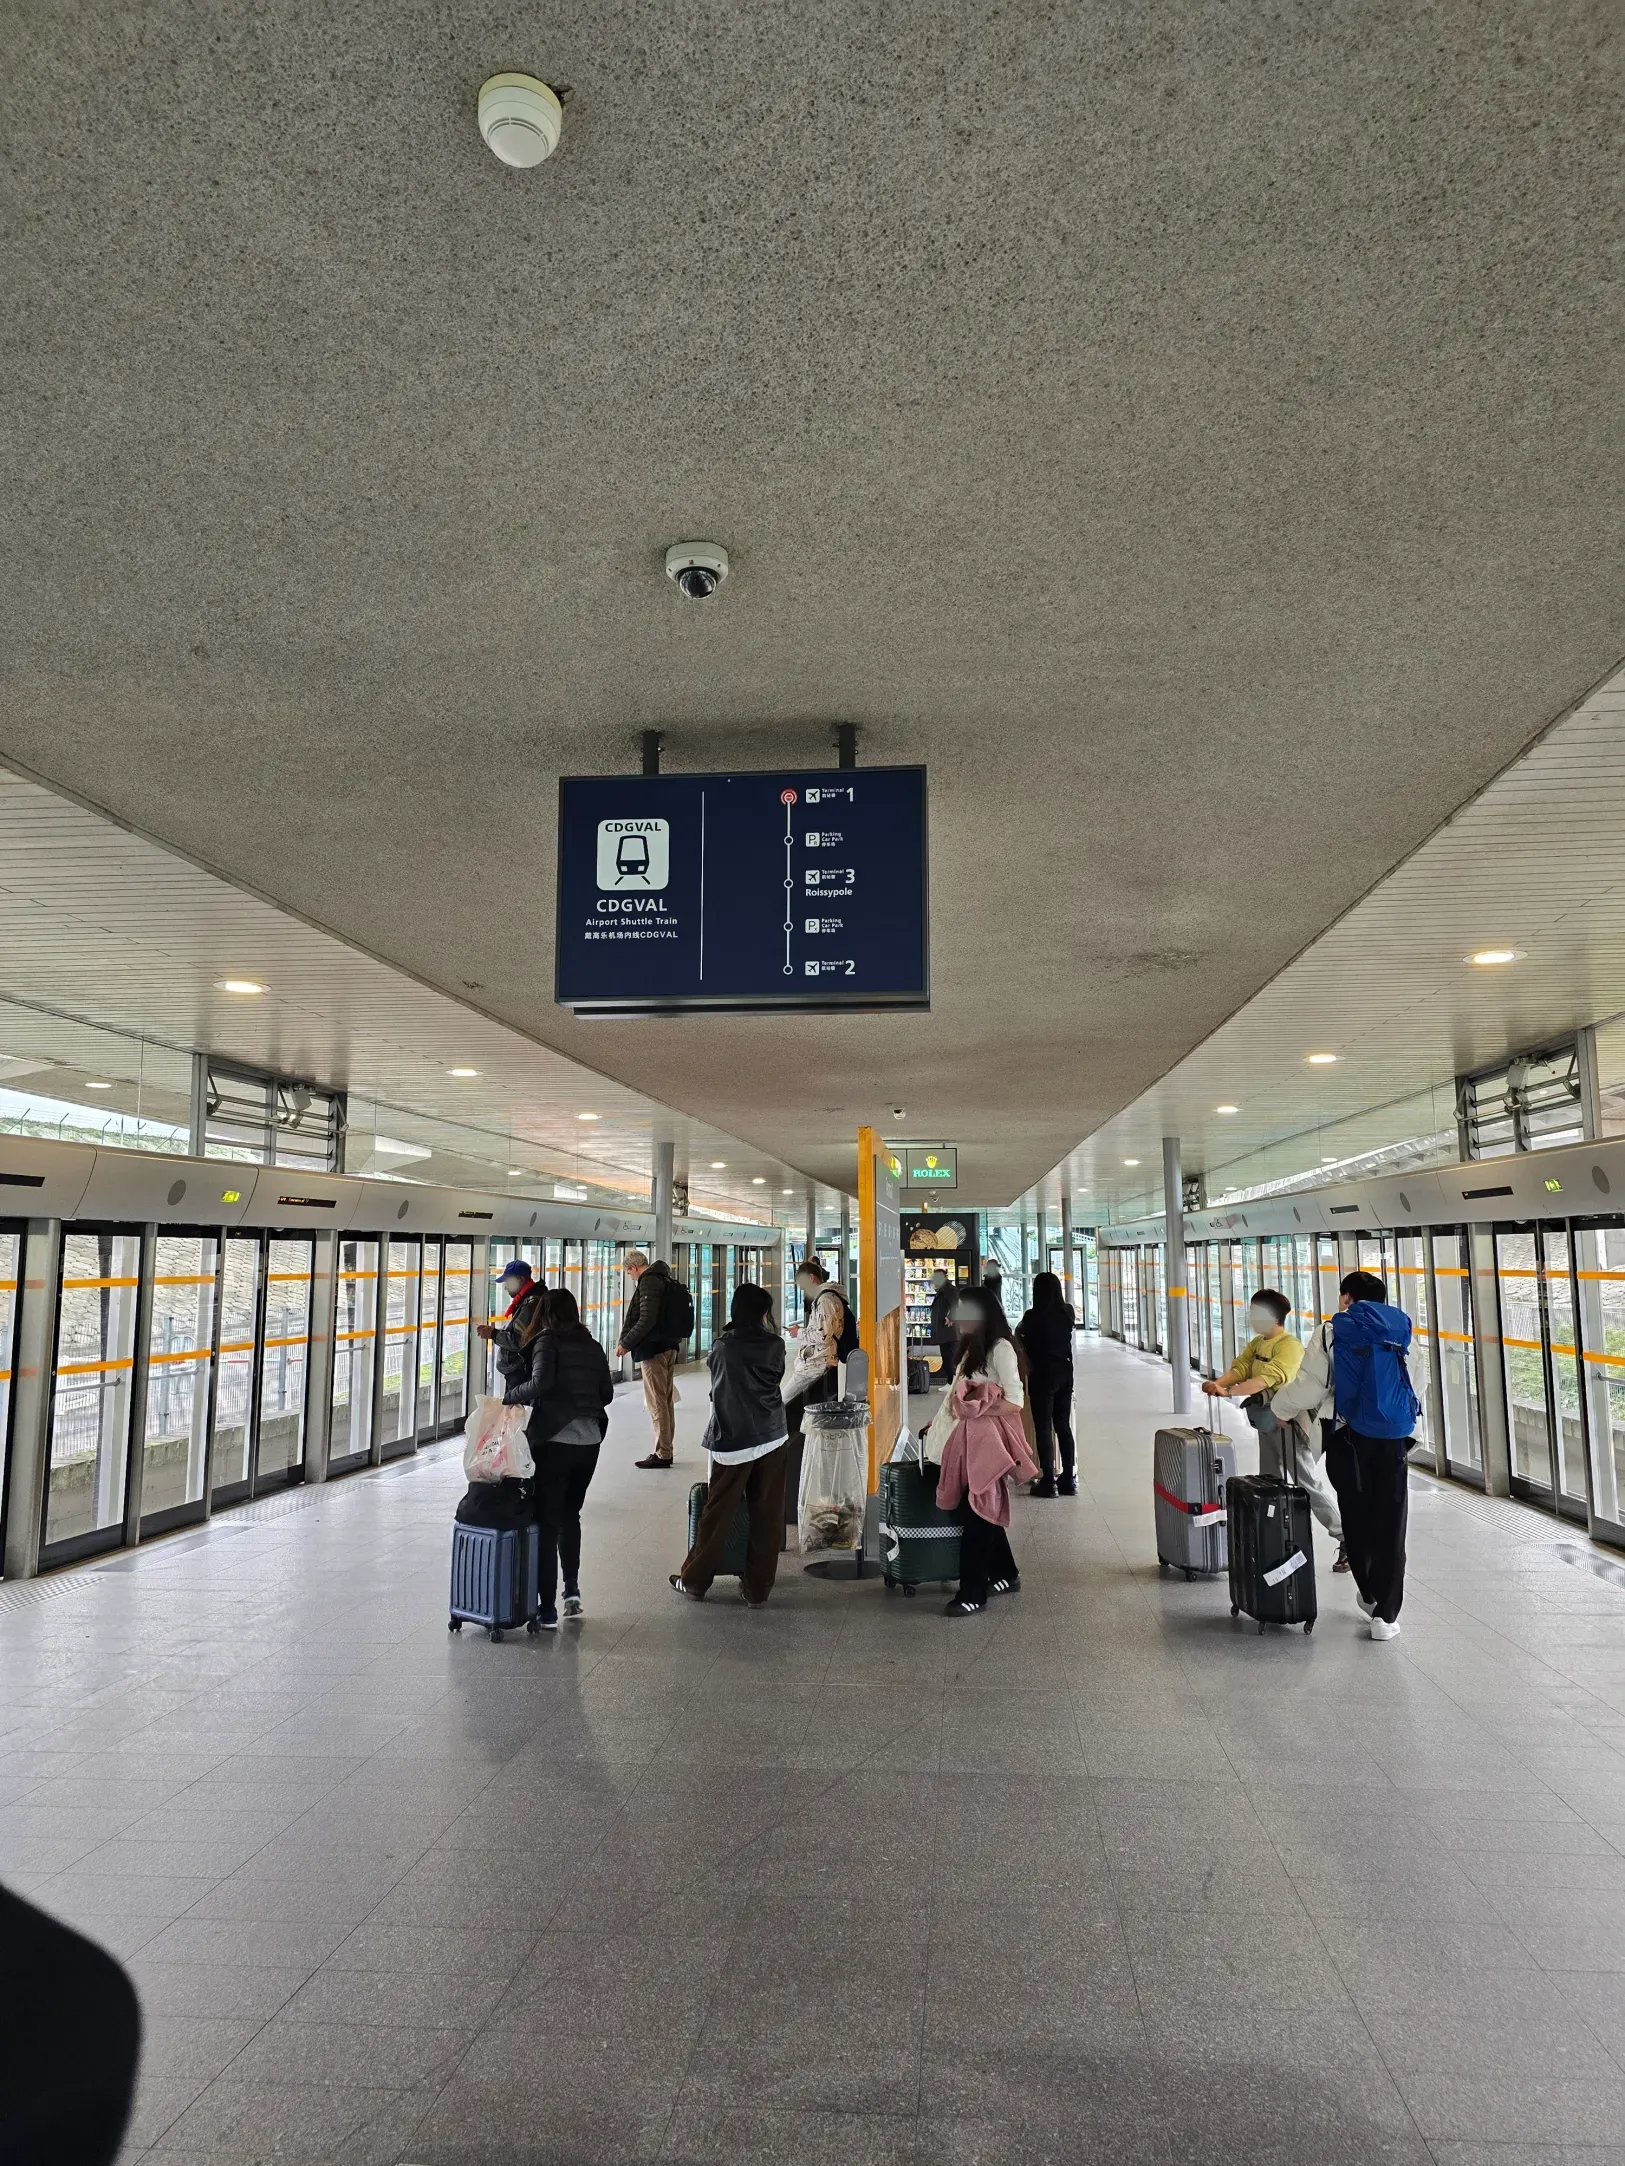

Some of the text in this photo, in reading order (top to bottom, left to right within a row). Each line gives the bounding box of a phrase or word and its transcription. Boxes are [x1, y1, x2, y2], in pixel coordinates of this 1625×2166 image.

[846, 787, 854, 802] 1
[605, 821, 662, 833] CDGVAL
[845, 868, 855, 884] 3
[805, 887, 853, 898] Roissypole
[596, 898, 668, 913] CDGVAL
[585, 916, 678, 927] Airport Shuttle Train
[845, 960, 856, 975] 2
[912, 1169, 951, 1178] ROLEX
